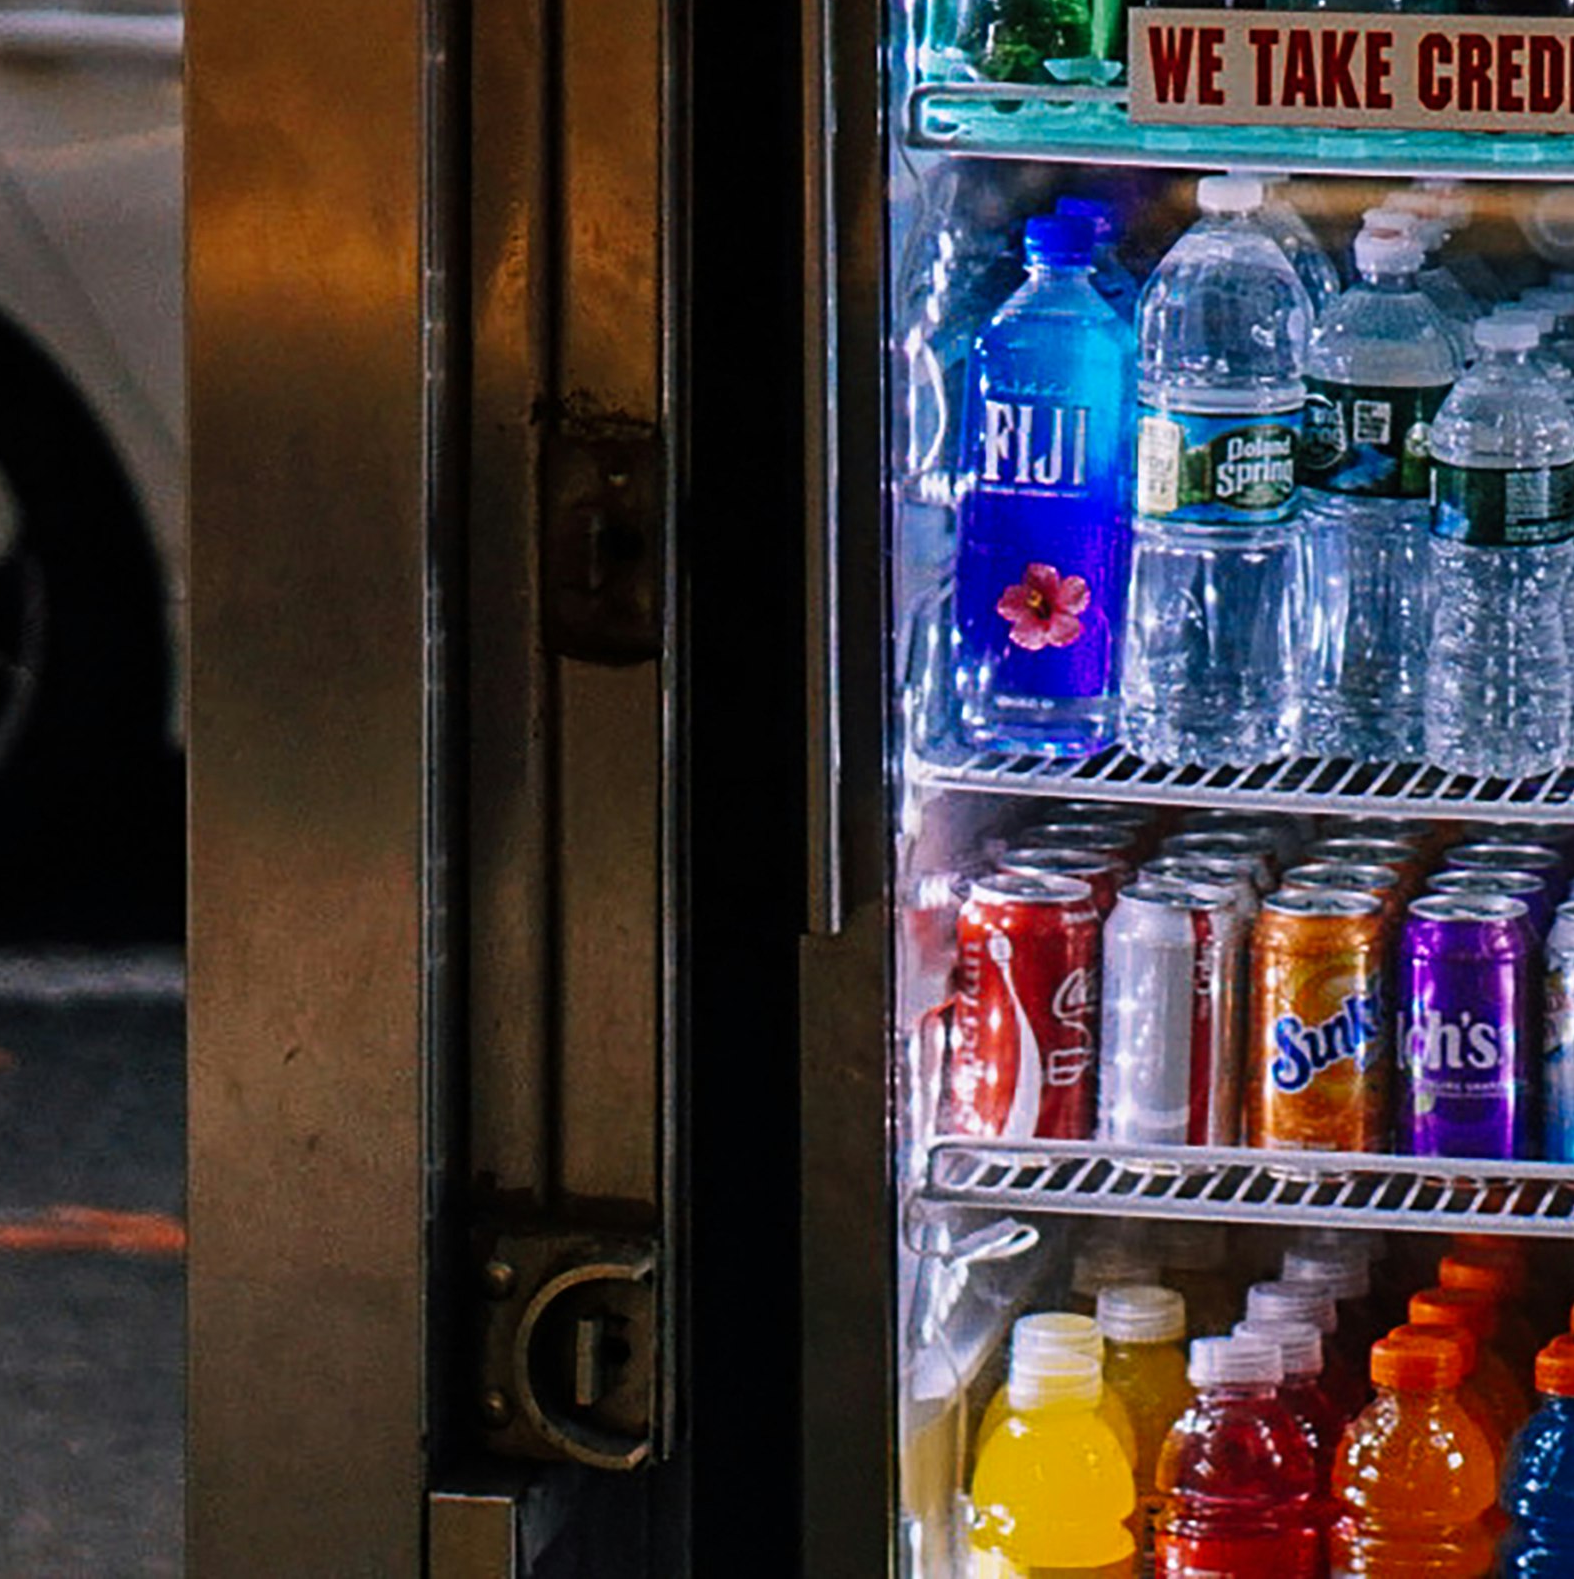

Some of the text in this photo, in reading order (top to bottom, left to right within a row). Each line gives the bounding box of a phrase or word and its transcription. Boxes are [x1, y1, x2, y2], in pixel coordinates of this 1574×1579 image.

[1146, 26, 1227, 107] WE
[1247, 28, 1394, 111] TAKE
[981, 399, 1089, 485] FIJI
[1227, 436, 1292, 462] Poland
[1216, 458, 1295, 499] Spring
